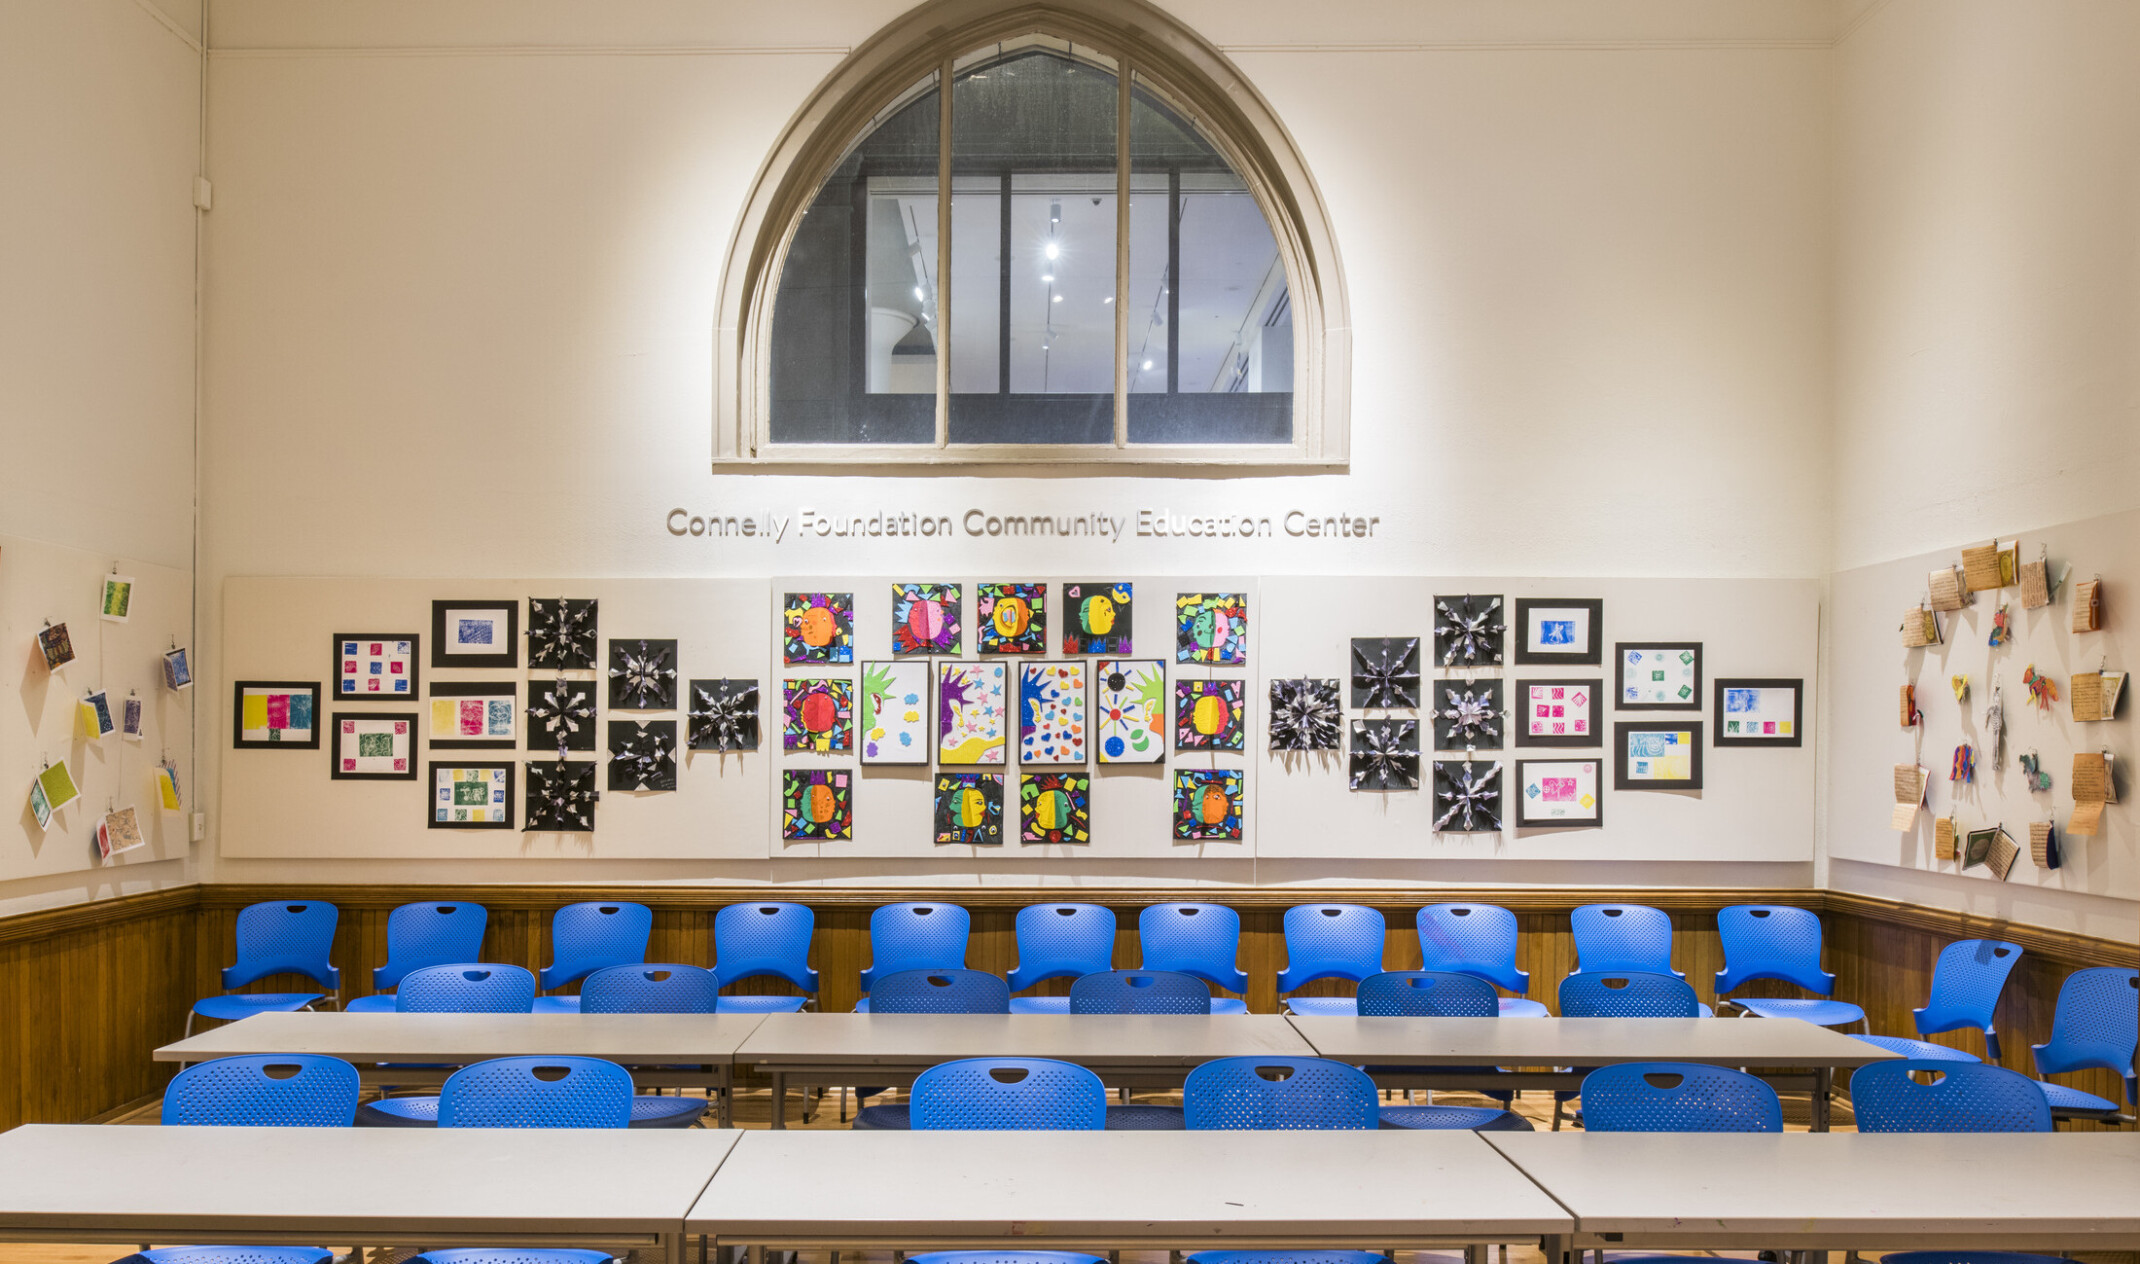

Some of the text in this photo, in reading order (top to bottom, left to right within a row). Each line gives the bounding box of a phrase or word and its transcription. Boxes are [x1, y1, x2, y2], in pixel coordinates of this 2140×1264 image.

[666, 507, 1380, 544] Connelly Foundation Community Education Center
